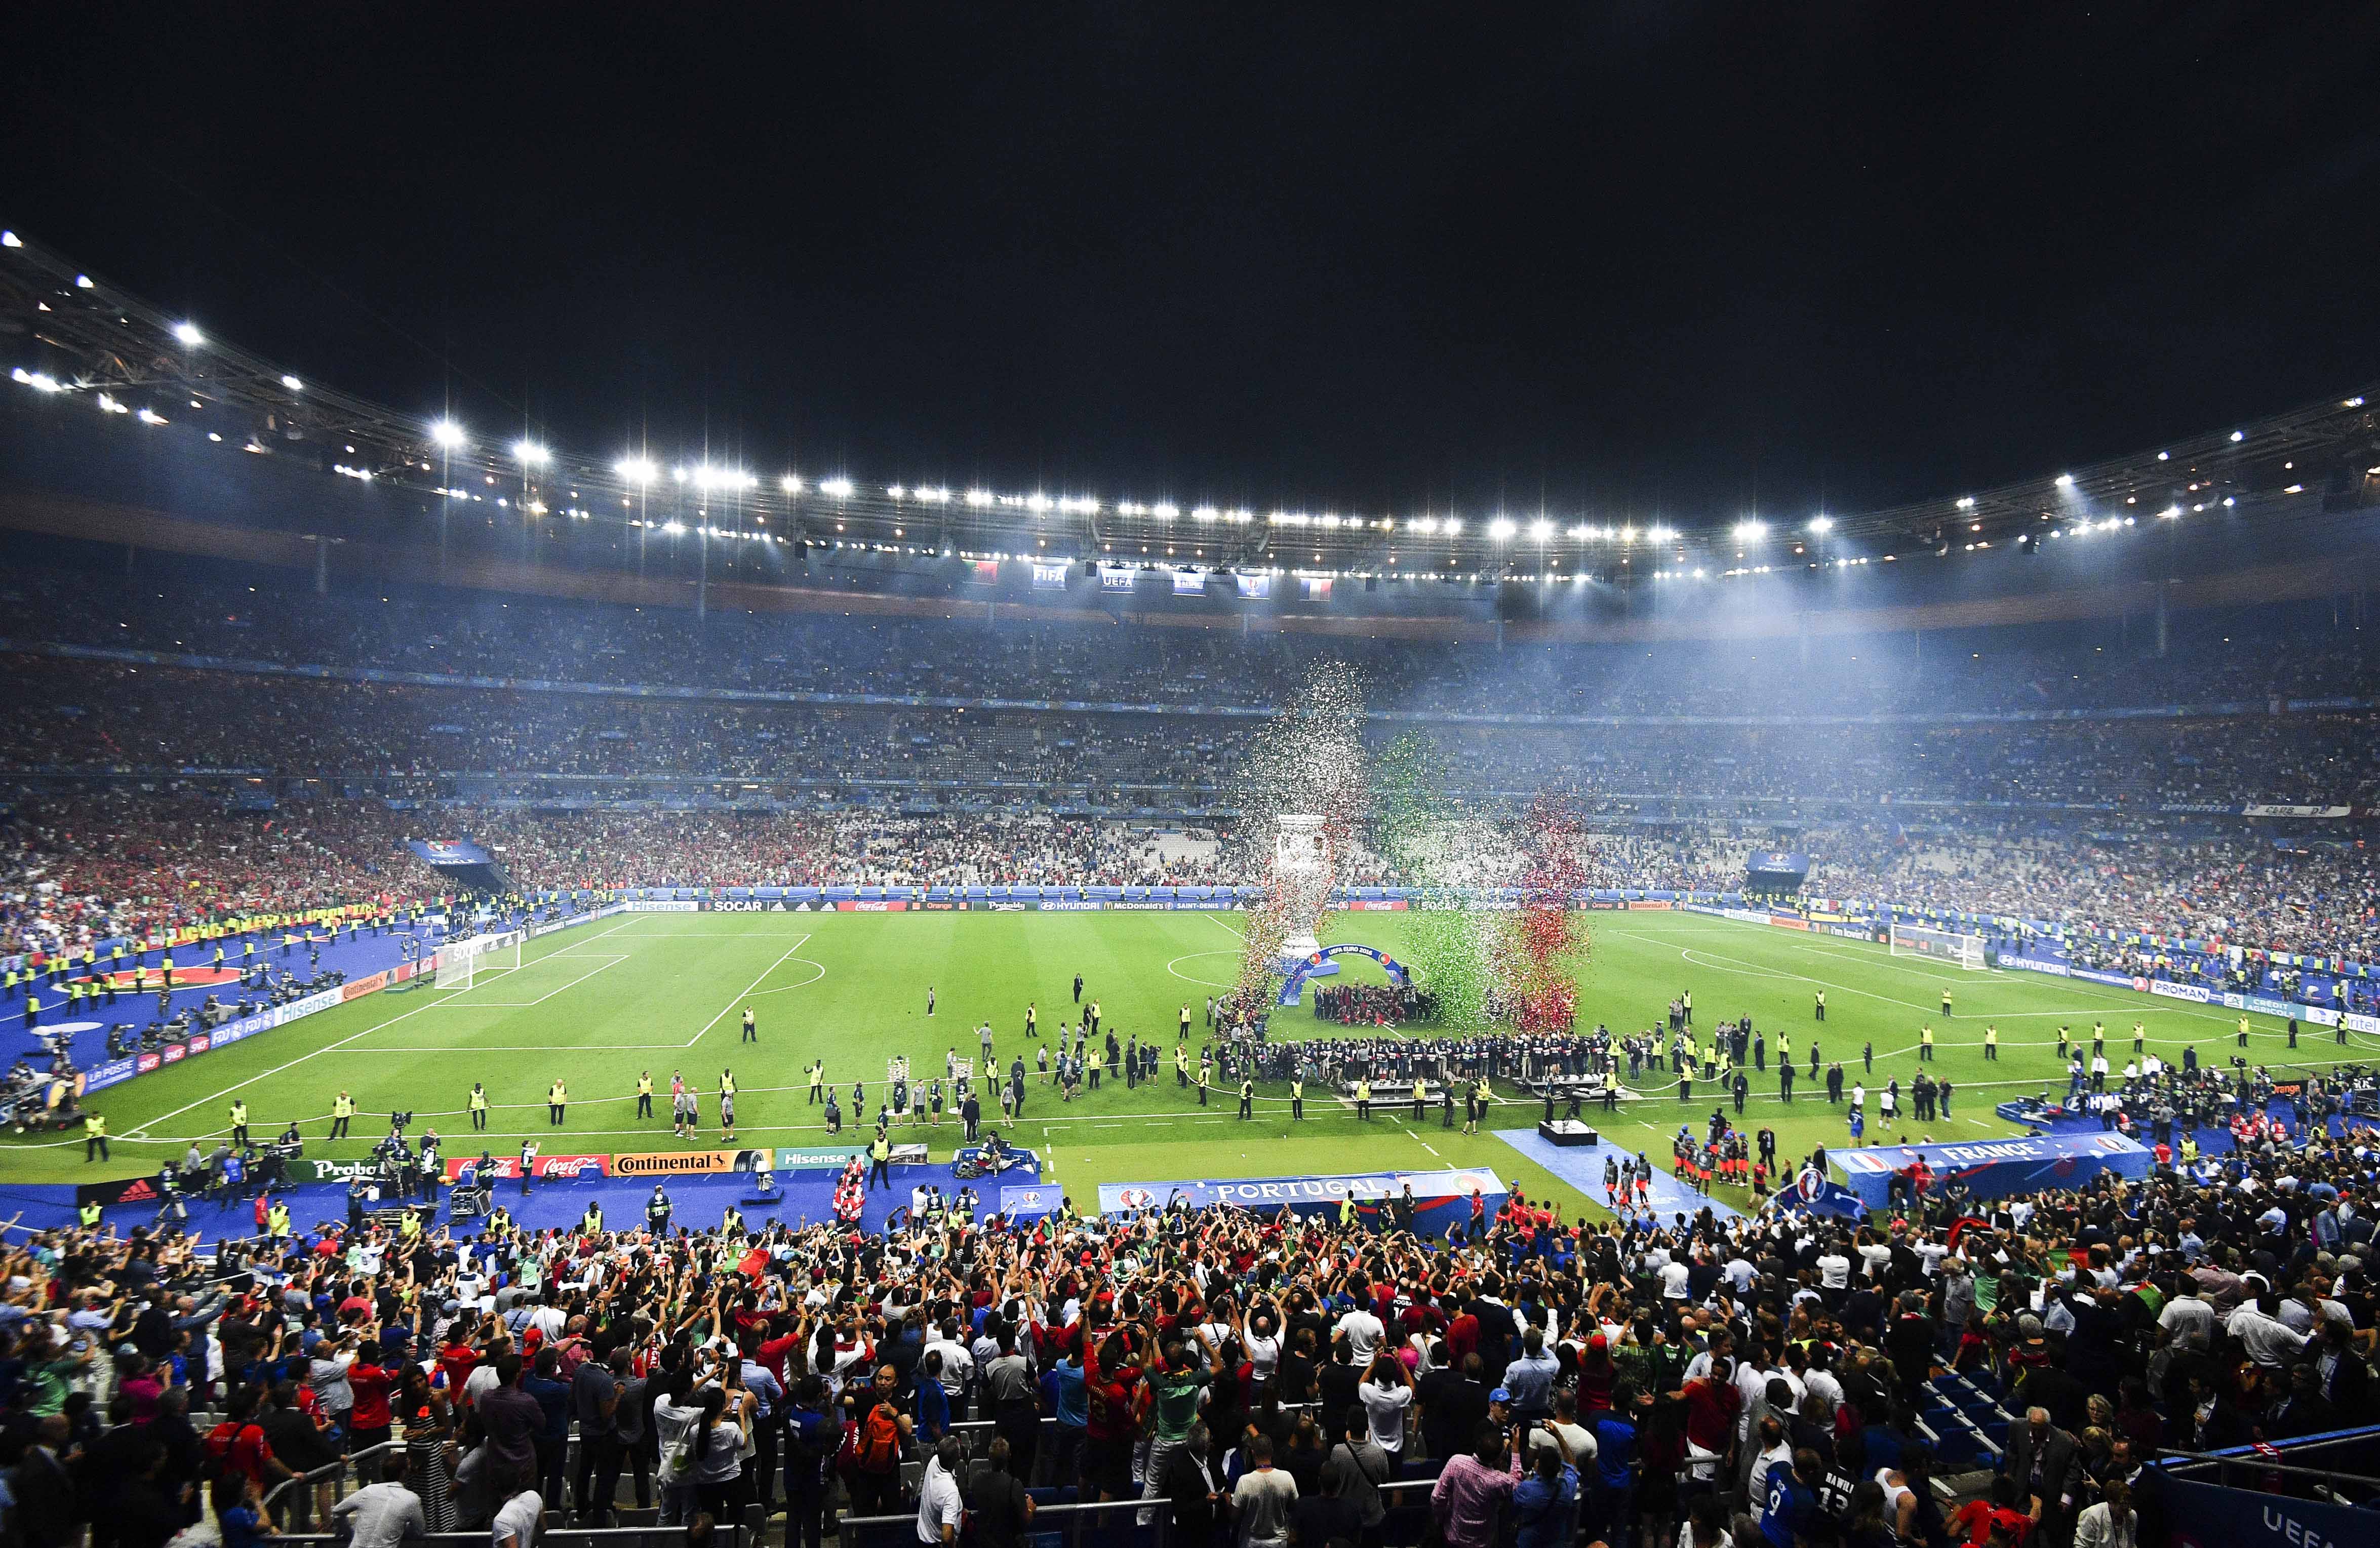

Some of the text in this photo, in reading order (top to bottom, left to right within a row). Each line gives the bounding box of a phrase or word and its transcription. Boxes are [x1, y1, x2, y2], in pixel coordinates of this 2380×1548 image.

[1033, 569, 1065, 582] FIFA
[1103, 576, 1132, 587] UEFA
[632, 902, 692, 911] Hisense
[713, 901, 762, 911] SOCAR
[988, 901, 1025, 909] Probably
[1056, 901, 1100, 910] HYUNDAI
[1114, 901, 1164, 910] McDonald's
[1729, 910, 1766, 923] Hisense
[1328, 947, 1343, 955] UEFA
[1359, 947, 1373, 956] 2016
[2015, 957, 2067, 975] HYUNDAI
[343, 976, 379, 999] Continental
[2156, 983, 2206, 1000] PROMAN
[282, 993, 336, 1022] Hisense
[244, 1018, 261, 1034] FDJ
[211, 1029, 231, 1045] FDJ
[189, 1039, 210, 1053] SNCF
[164, 1048, 186, 1062] SNCF
[89, 1070, 102, 1083] LA
[102, 1059, 134, 1079] POSTE
[137, 1057, 160, 1071] SNCF
[1939, 1142, 2043, 1161] FRANCE
[618, 1155, 711, 1173] Continental
[785, 1154, 847, 1165] Hisense
[1217, 1178, 1384, 1200] PORTUGAL
[1768, 1489, 1781, 1516] 9
[2264, 1505, 2334, 1548] UEF
